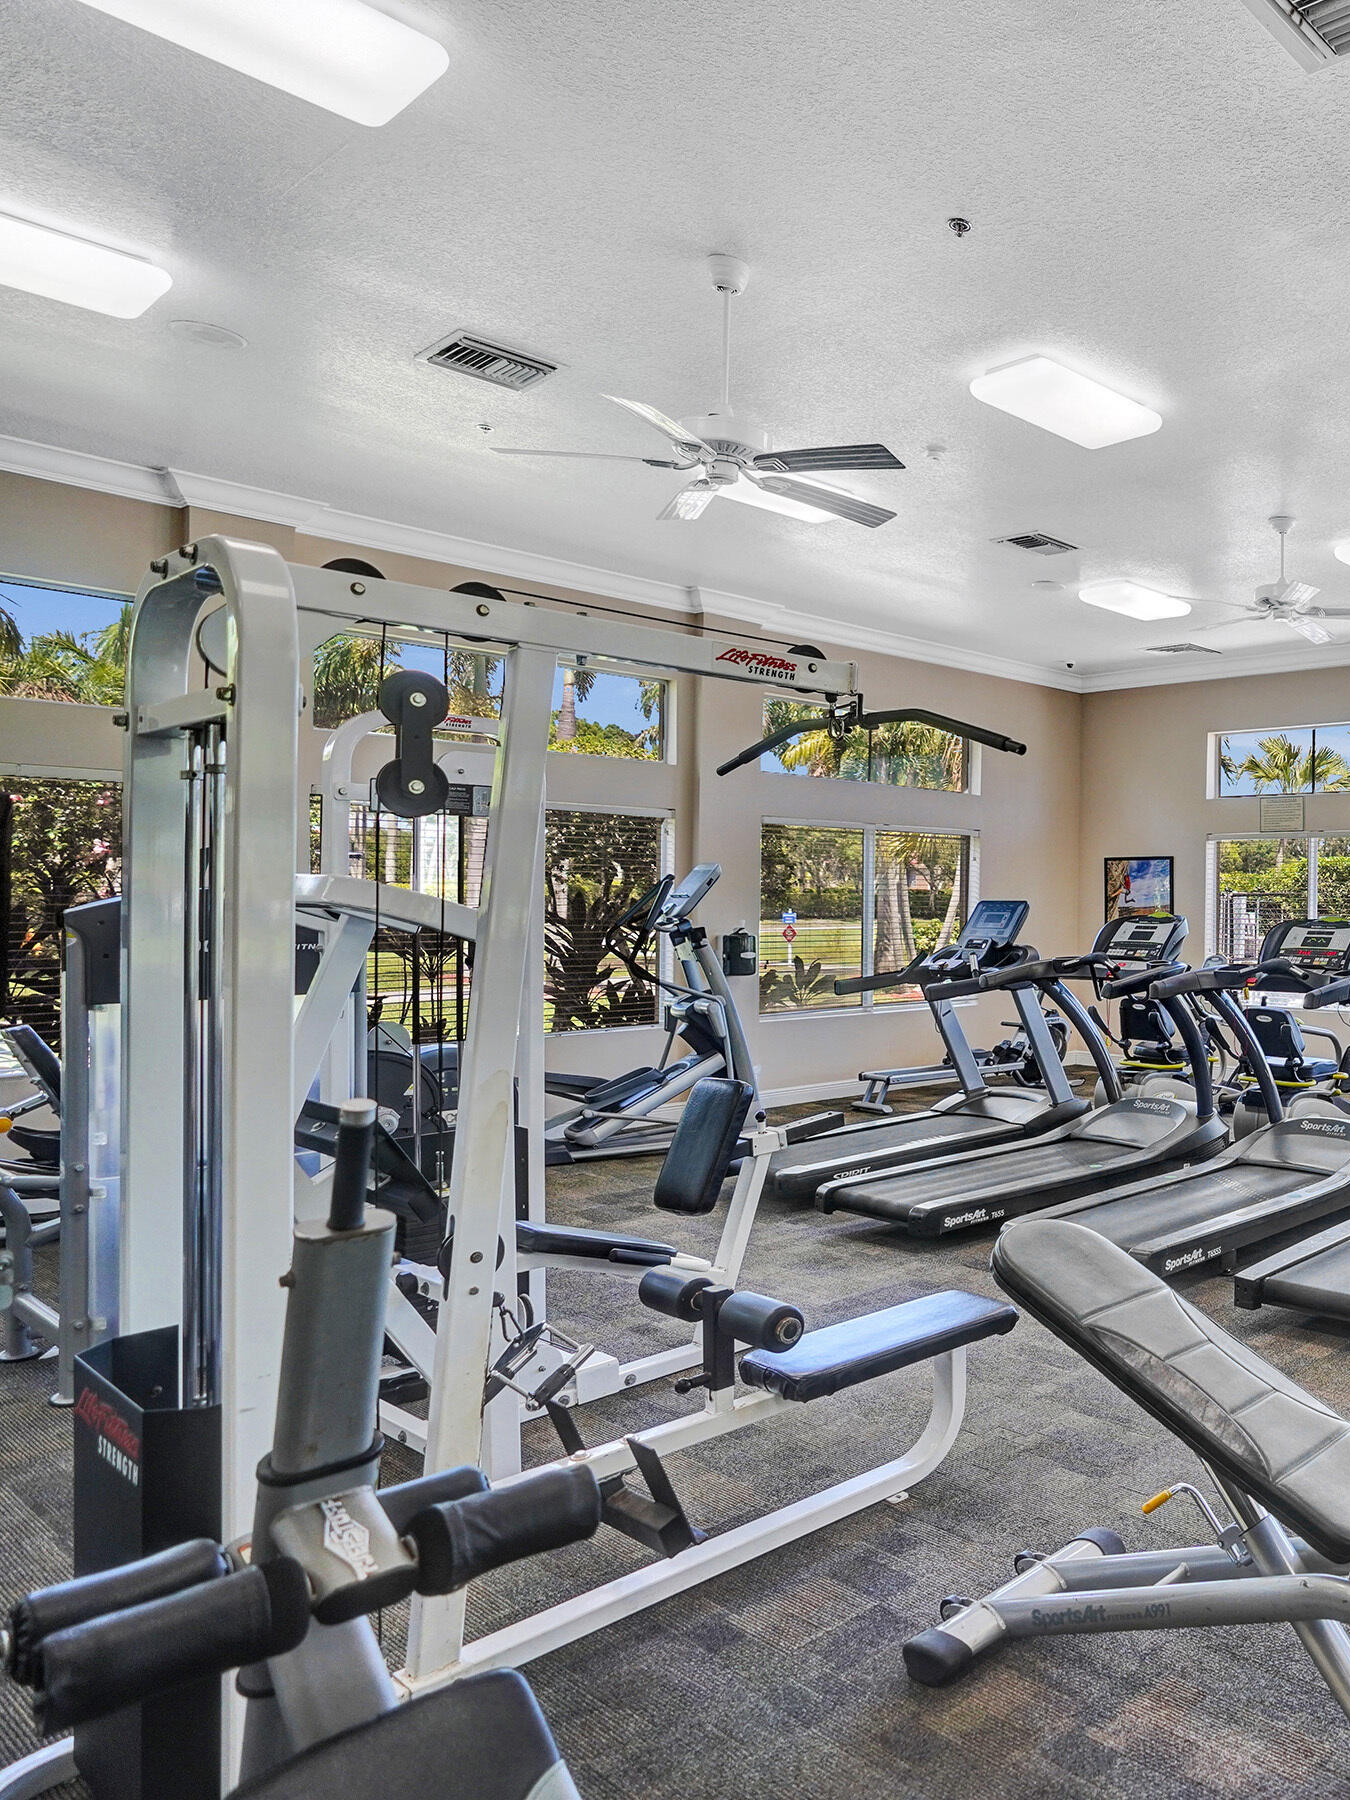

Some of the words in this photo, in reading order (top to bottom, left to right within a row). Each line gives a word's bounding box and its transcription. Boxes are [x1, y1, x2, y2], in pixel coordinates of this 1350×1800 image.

[716, 648, 748, 665] Life
[746, 654, 797, 672] Fitness
[748, 666, 795, 680] STRENGTH
[1134, 1099, 1170, 1111] SportsArt
[1300, 1120, 1346, 1132] SportsArt
[944, 1208, 987, 1228] SportsArt
[1165, 1248, 1202, 1271] SportsArt
[98, 1435, 139, 1487] STRENGTH
[1031, 1605, 1106, 1630] SportsArt
[1144, 1603, 1171, 1618] A991
